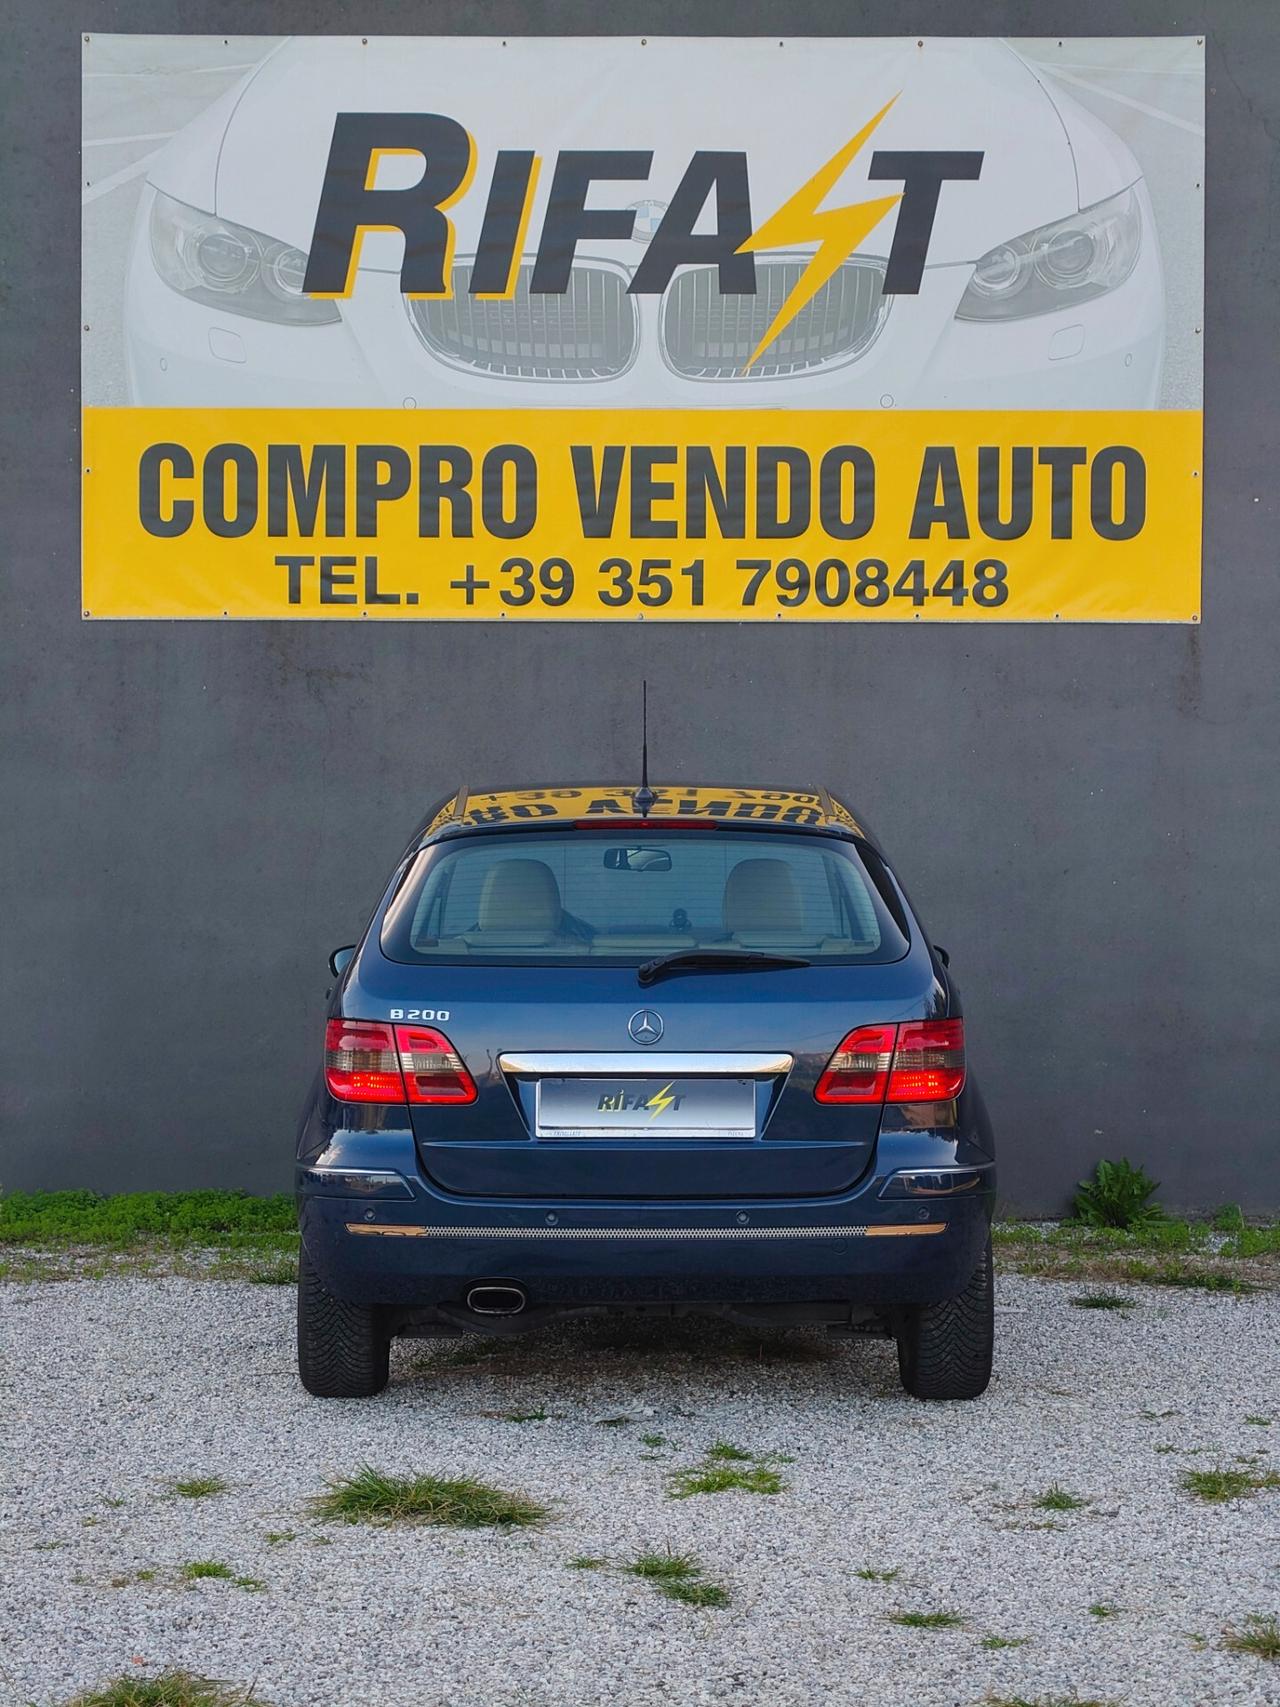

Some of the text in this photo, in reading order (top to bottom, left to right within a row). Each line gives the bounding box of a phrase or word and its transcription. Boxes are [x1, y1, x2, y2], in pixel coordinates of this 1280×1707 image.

[139, 442, 1147, 541] COMPRO VENDO AUTO
[274, 555, 1010, 608] TEL. +39 351 7908448
[390, 1008, 450, 1021] B 200
